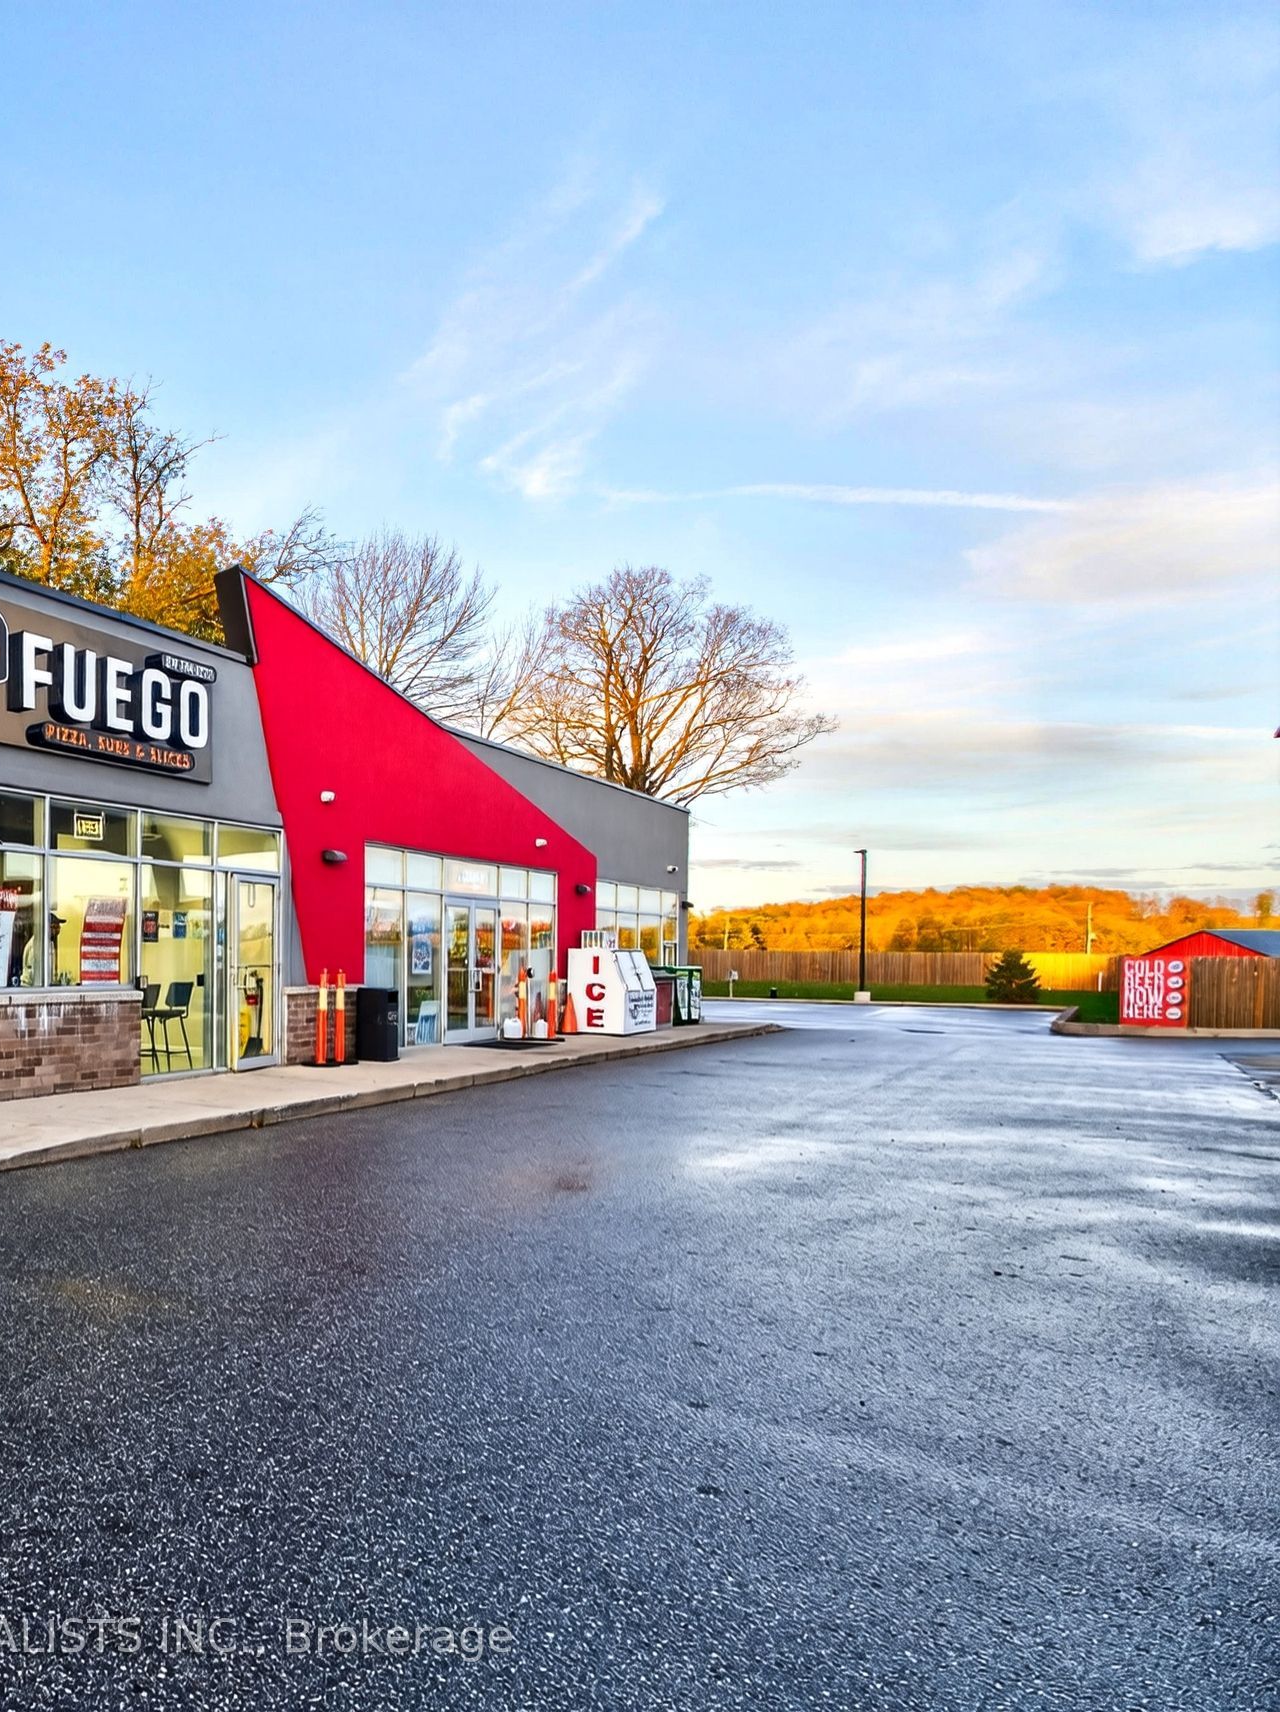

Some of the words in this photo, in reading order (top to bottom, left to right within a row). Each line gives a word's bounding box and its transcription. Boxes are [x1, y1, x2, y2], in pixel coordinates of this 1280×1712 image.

[22, 631, 208, 749] FUEGO
[44, 722, 92, 750] PIZZA,
[98, 735, 130, 757] SUBS
[135, 743, 146, 759] &
[150, 746, 191, 770] SLICES
[1124, 960, 1165, 976] COLD
[1124, 973, 1165, 989] BEER
[585, 955, 606, 1028] ICE
[1124, 987, 1164, 1006] NOW
[1123, 1003, 1163, 1019] HERE
